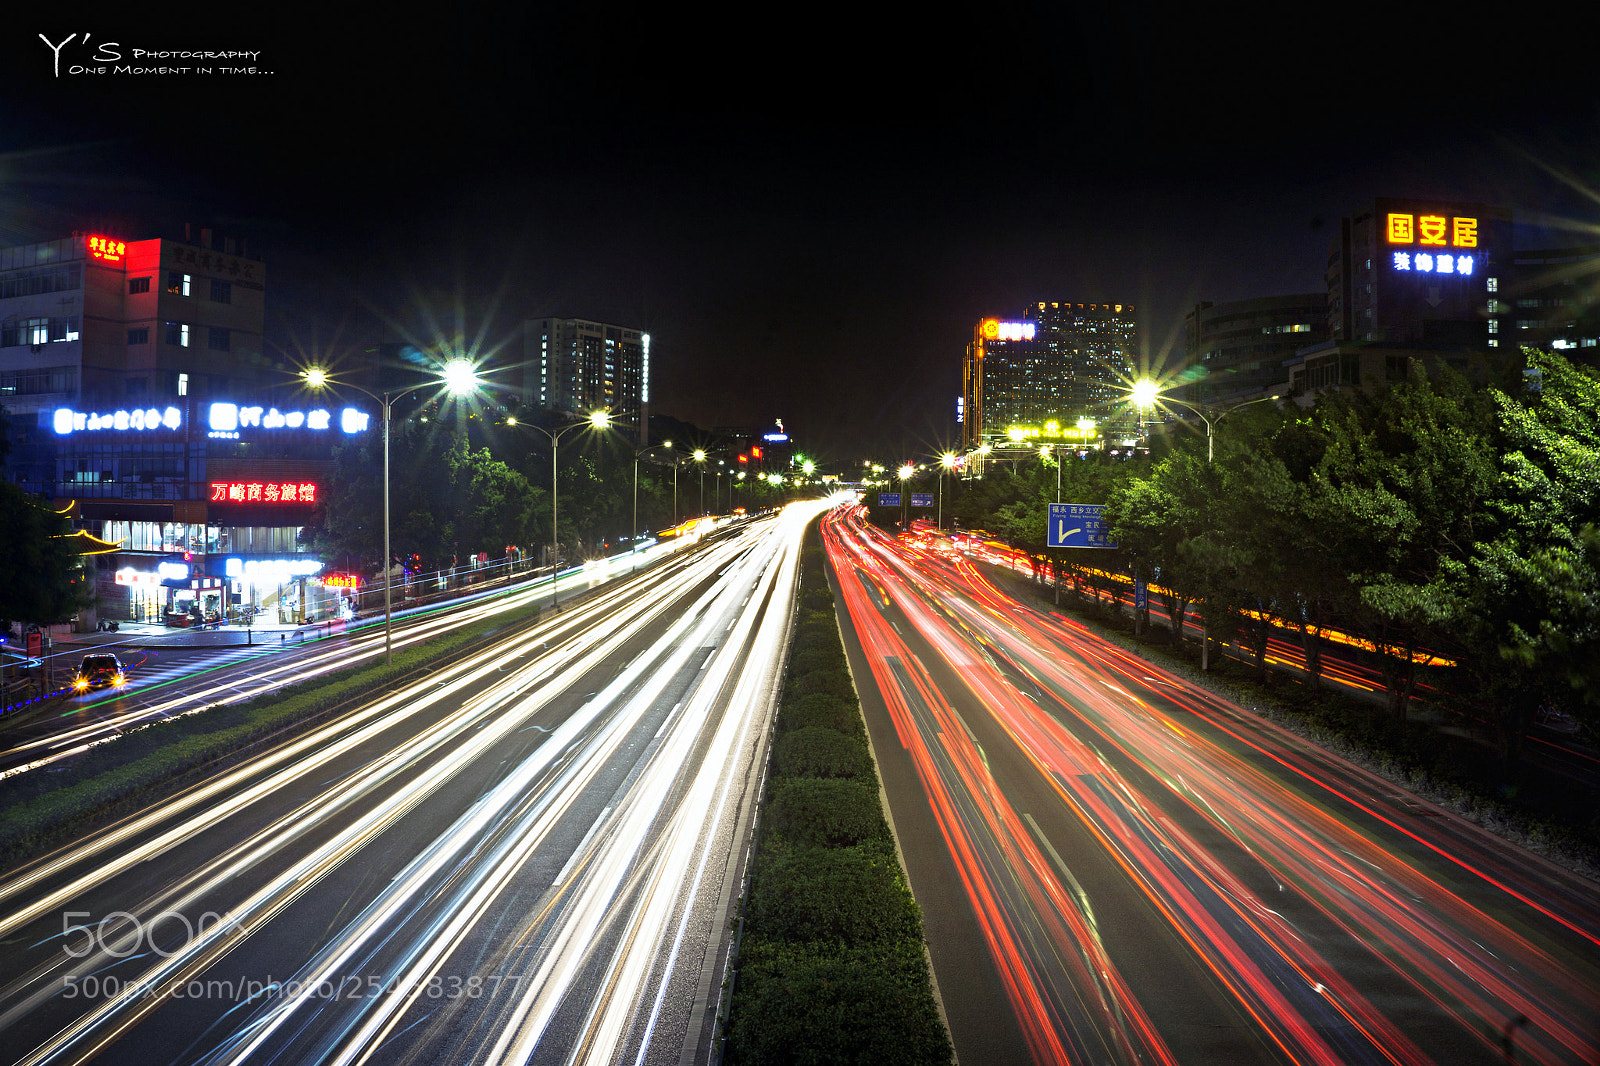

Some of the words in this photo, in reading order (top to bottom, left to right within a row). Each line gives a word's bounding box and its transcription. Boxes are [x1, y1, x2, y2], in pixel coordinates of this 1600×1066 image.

[1387, 213, 1478, 248] 国安居
[211, 482, 316, 502] 万峰商务旅馆
